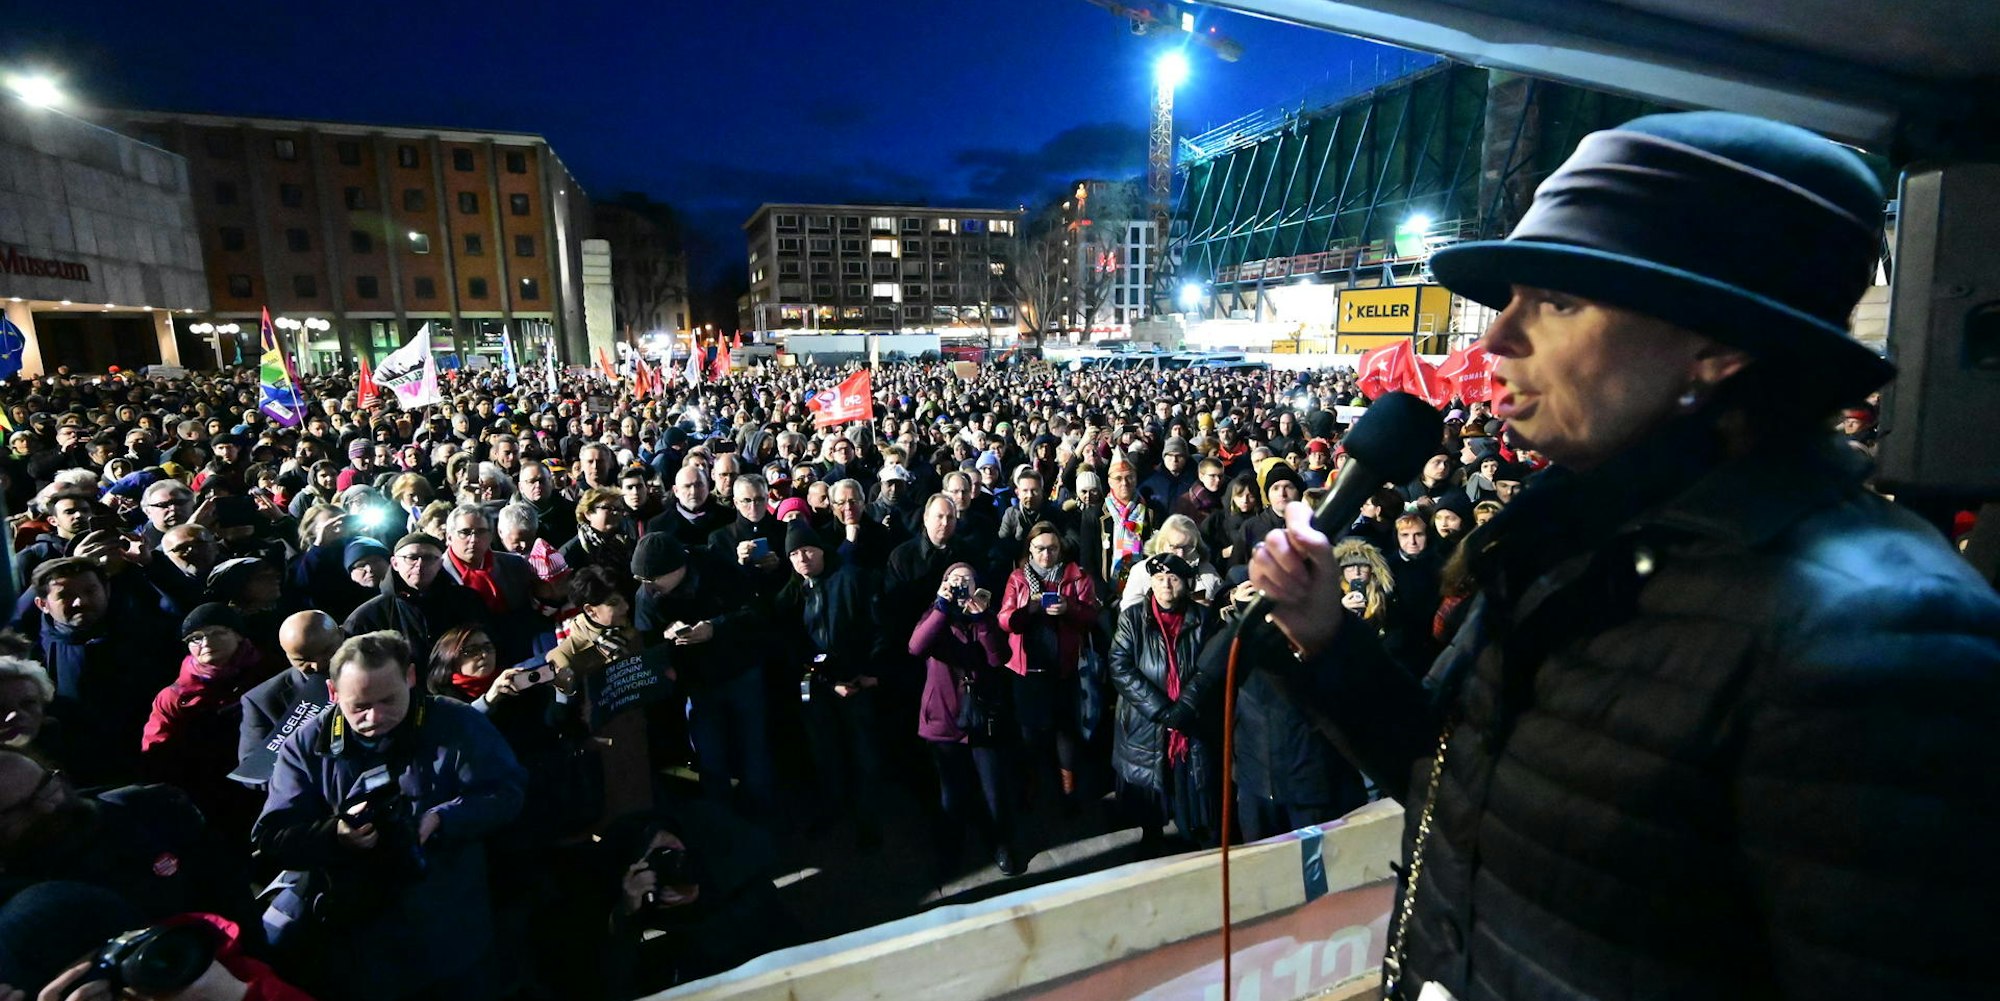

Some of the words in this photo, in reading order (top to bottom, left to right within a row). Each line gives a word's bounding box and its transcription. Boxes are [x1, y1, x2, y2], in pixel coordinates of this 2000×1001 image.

[1357, 304, 1409, 318] KELLER
[616, 656, 642, 669] GELEK
[614, 669, 652, 688] TRAUERN!
[266, 733, 286, 752] EM
[281, 700, 312, 734] GELEK
